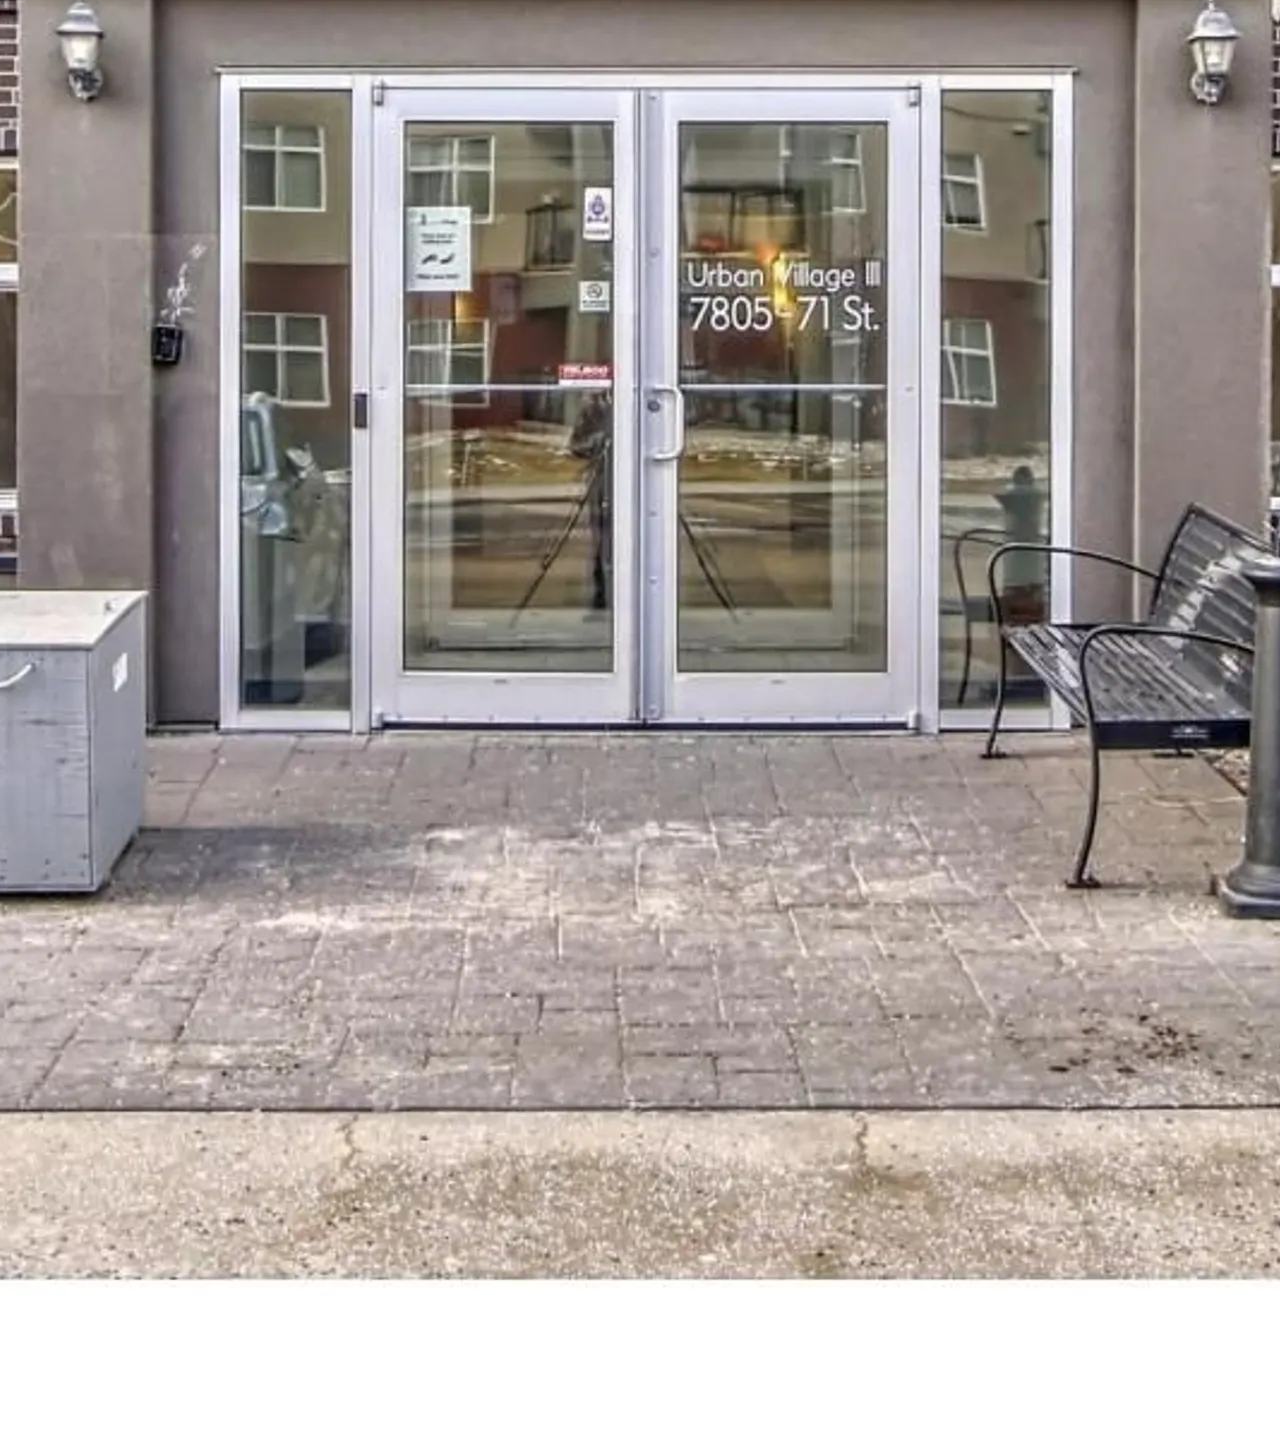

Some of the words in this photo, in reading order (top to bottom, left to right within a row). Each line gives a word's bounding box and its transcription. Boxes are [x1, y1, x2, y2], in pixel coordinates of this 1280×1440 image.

[687, 261, 764, 287] Urban
[773, 260, 855, 291] Village
[842, 295, 881, 330] St.
